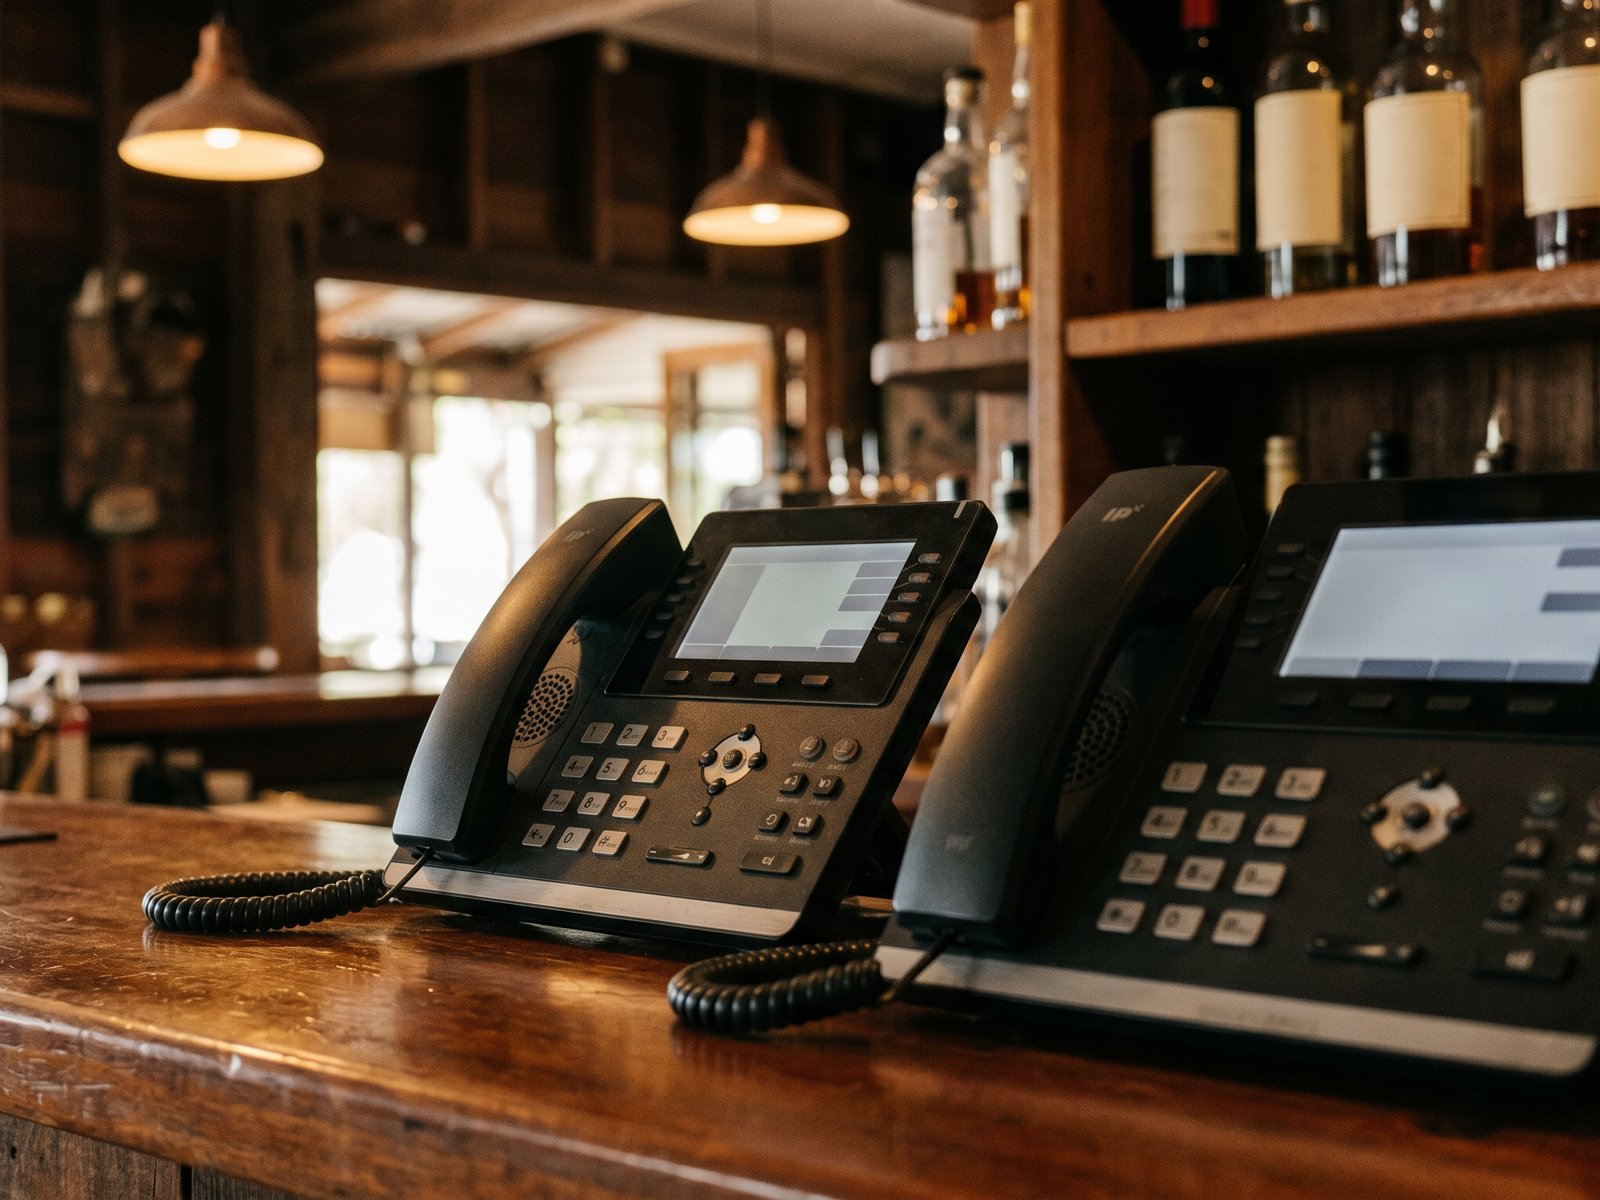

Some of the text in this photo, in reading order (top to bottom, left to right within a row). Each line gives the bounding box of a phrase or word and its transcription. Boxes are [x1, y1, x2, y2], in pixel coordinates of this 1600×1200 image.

[589, 726, 597, 737] 1
[623, 727, 633, 739] 2
[657, 730, 668, 741] 3
[567, 760, 576, 771] 4
[603, 762, 613, 774] 5
[637, 764, 648, 776] 6
[549, 794, 560, 806] 7
[584, 797, 594, 809] 8
[618, 800, 628, 811] 9
[563, 832, 574, 844] 0
